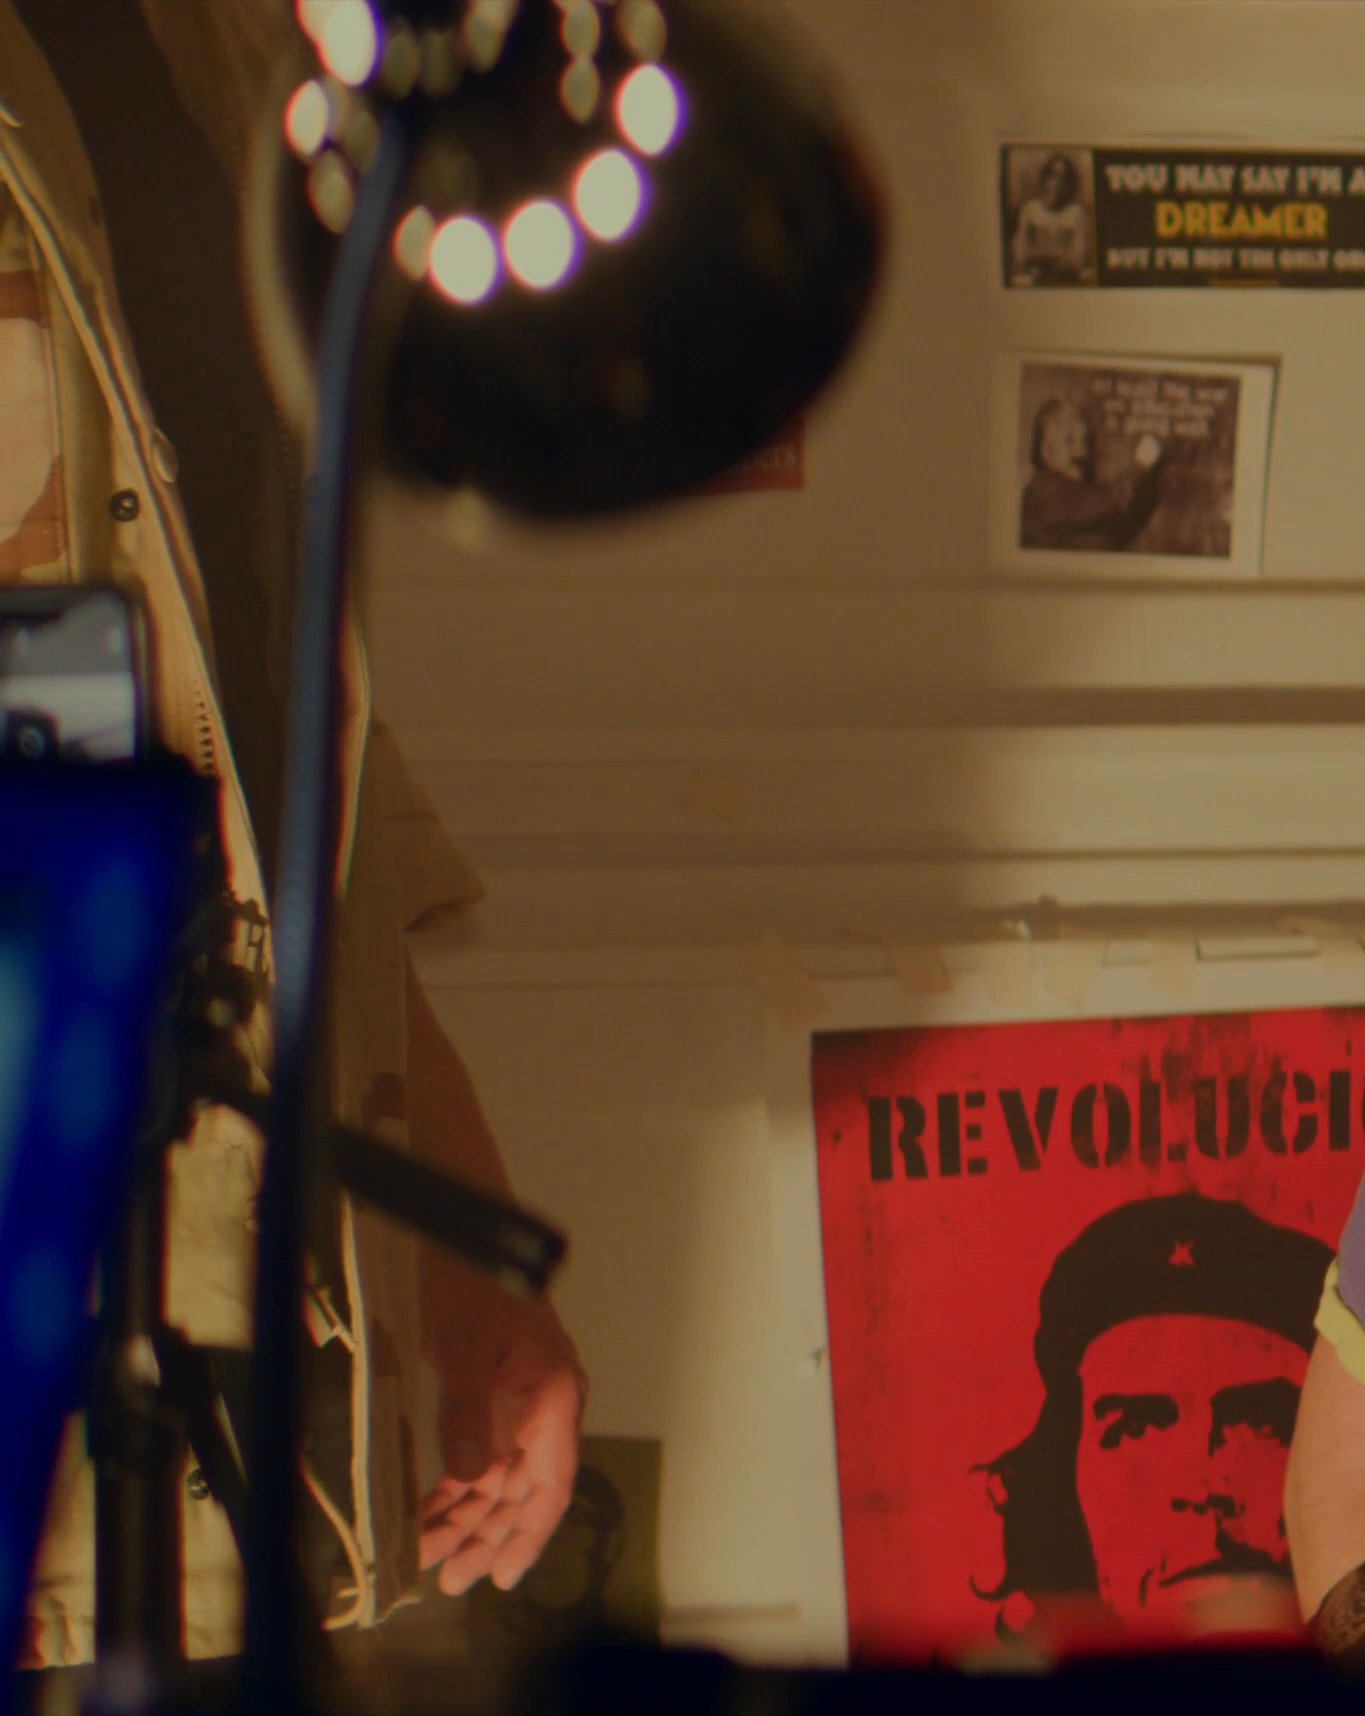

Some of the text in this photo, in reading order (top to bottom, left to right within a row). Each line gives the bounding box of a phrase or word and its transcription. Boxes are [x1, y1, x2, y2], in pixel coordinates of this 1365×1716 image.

[1106, 165, 1168, 193] YOU
[1175, 165, 1234, 194] MAY
[1241, 166, 1290, 195] SAY
[1296, 167, 1343, 195] I'M
[1155, 201, 1328, 239] DREAMER
